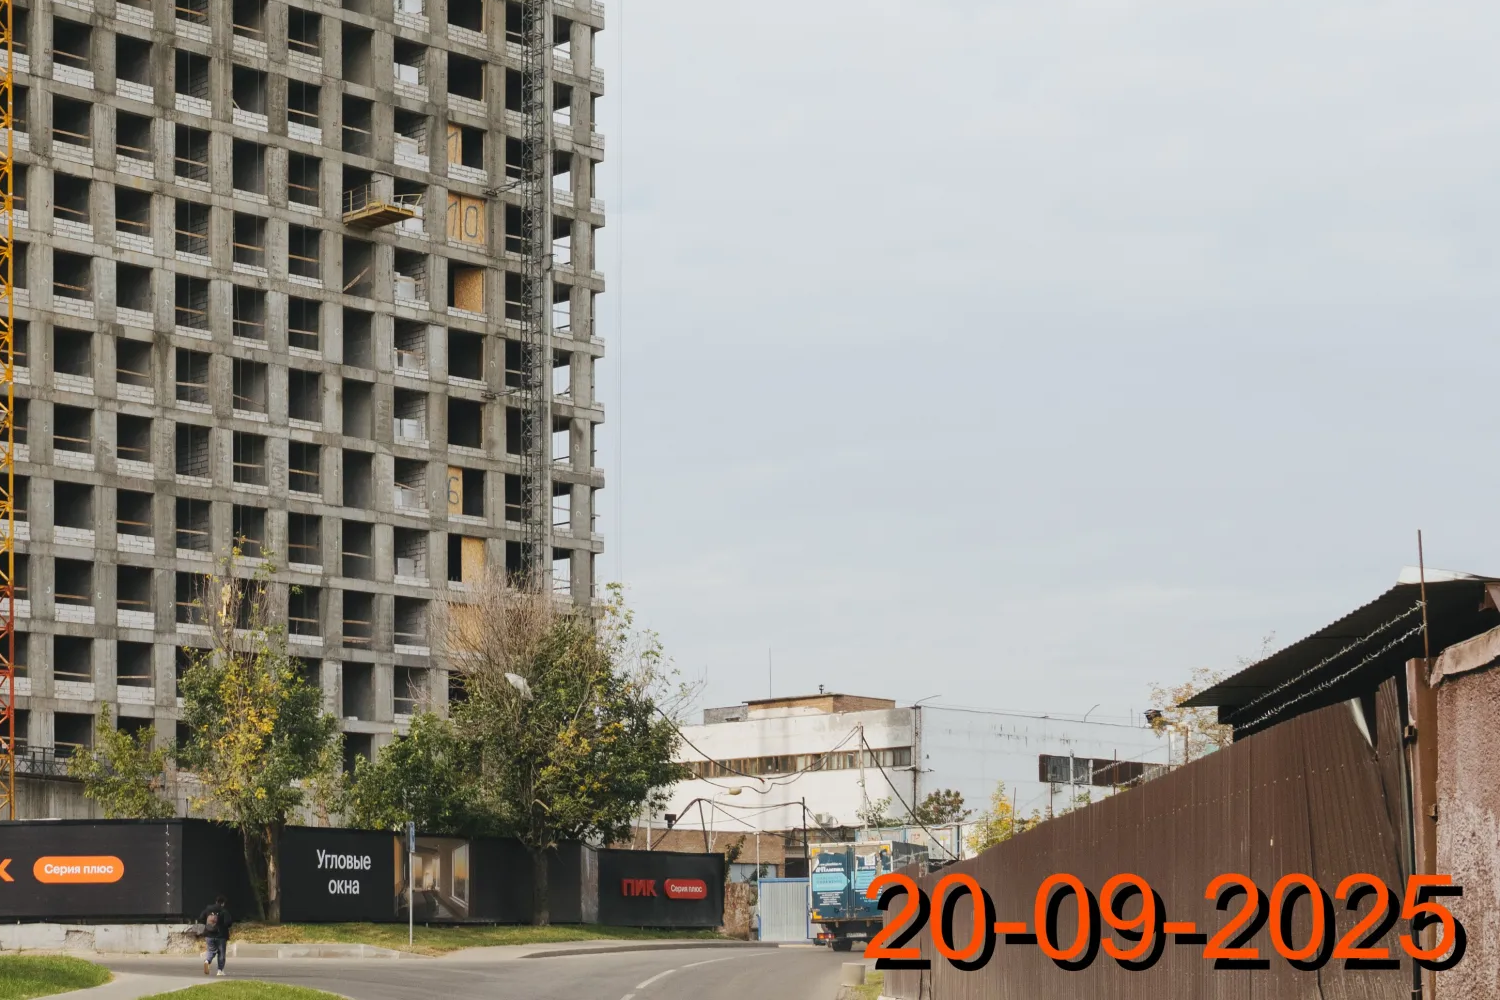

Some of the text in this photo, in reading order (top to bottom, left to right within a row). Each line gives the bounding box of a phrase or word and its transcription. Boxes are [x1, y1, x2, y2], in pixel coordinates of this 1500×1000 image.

[447, 201, 479, 238] 10
[447, 476, 460, 505] 6
[316, 849, 372, 870] Угловые
[44, 863, 114, 877] Серия плюс
[328, 879, 360, 895] окна
[622, 879, 658, 897] ПИК
[670, 884, 689, 893] Серия
